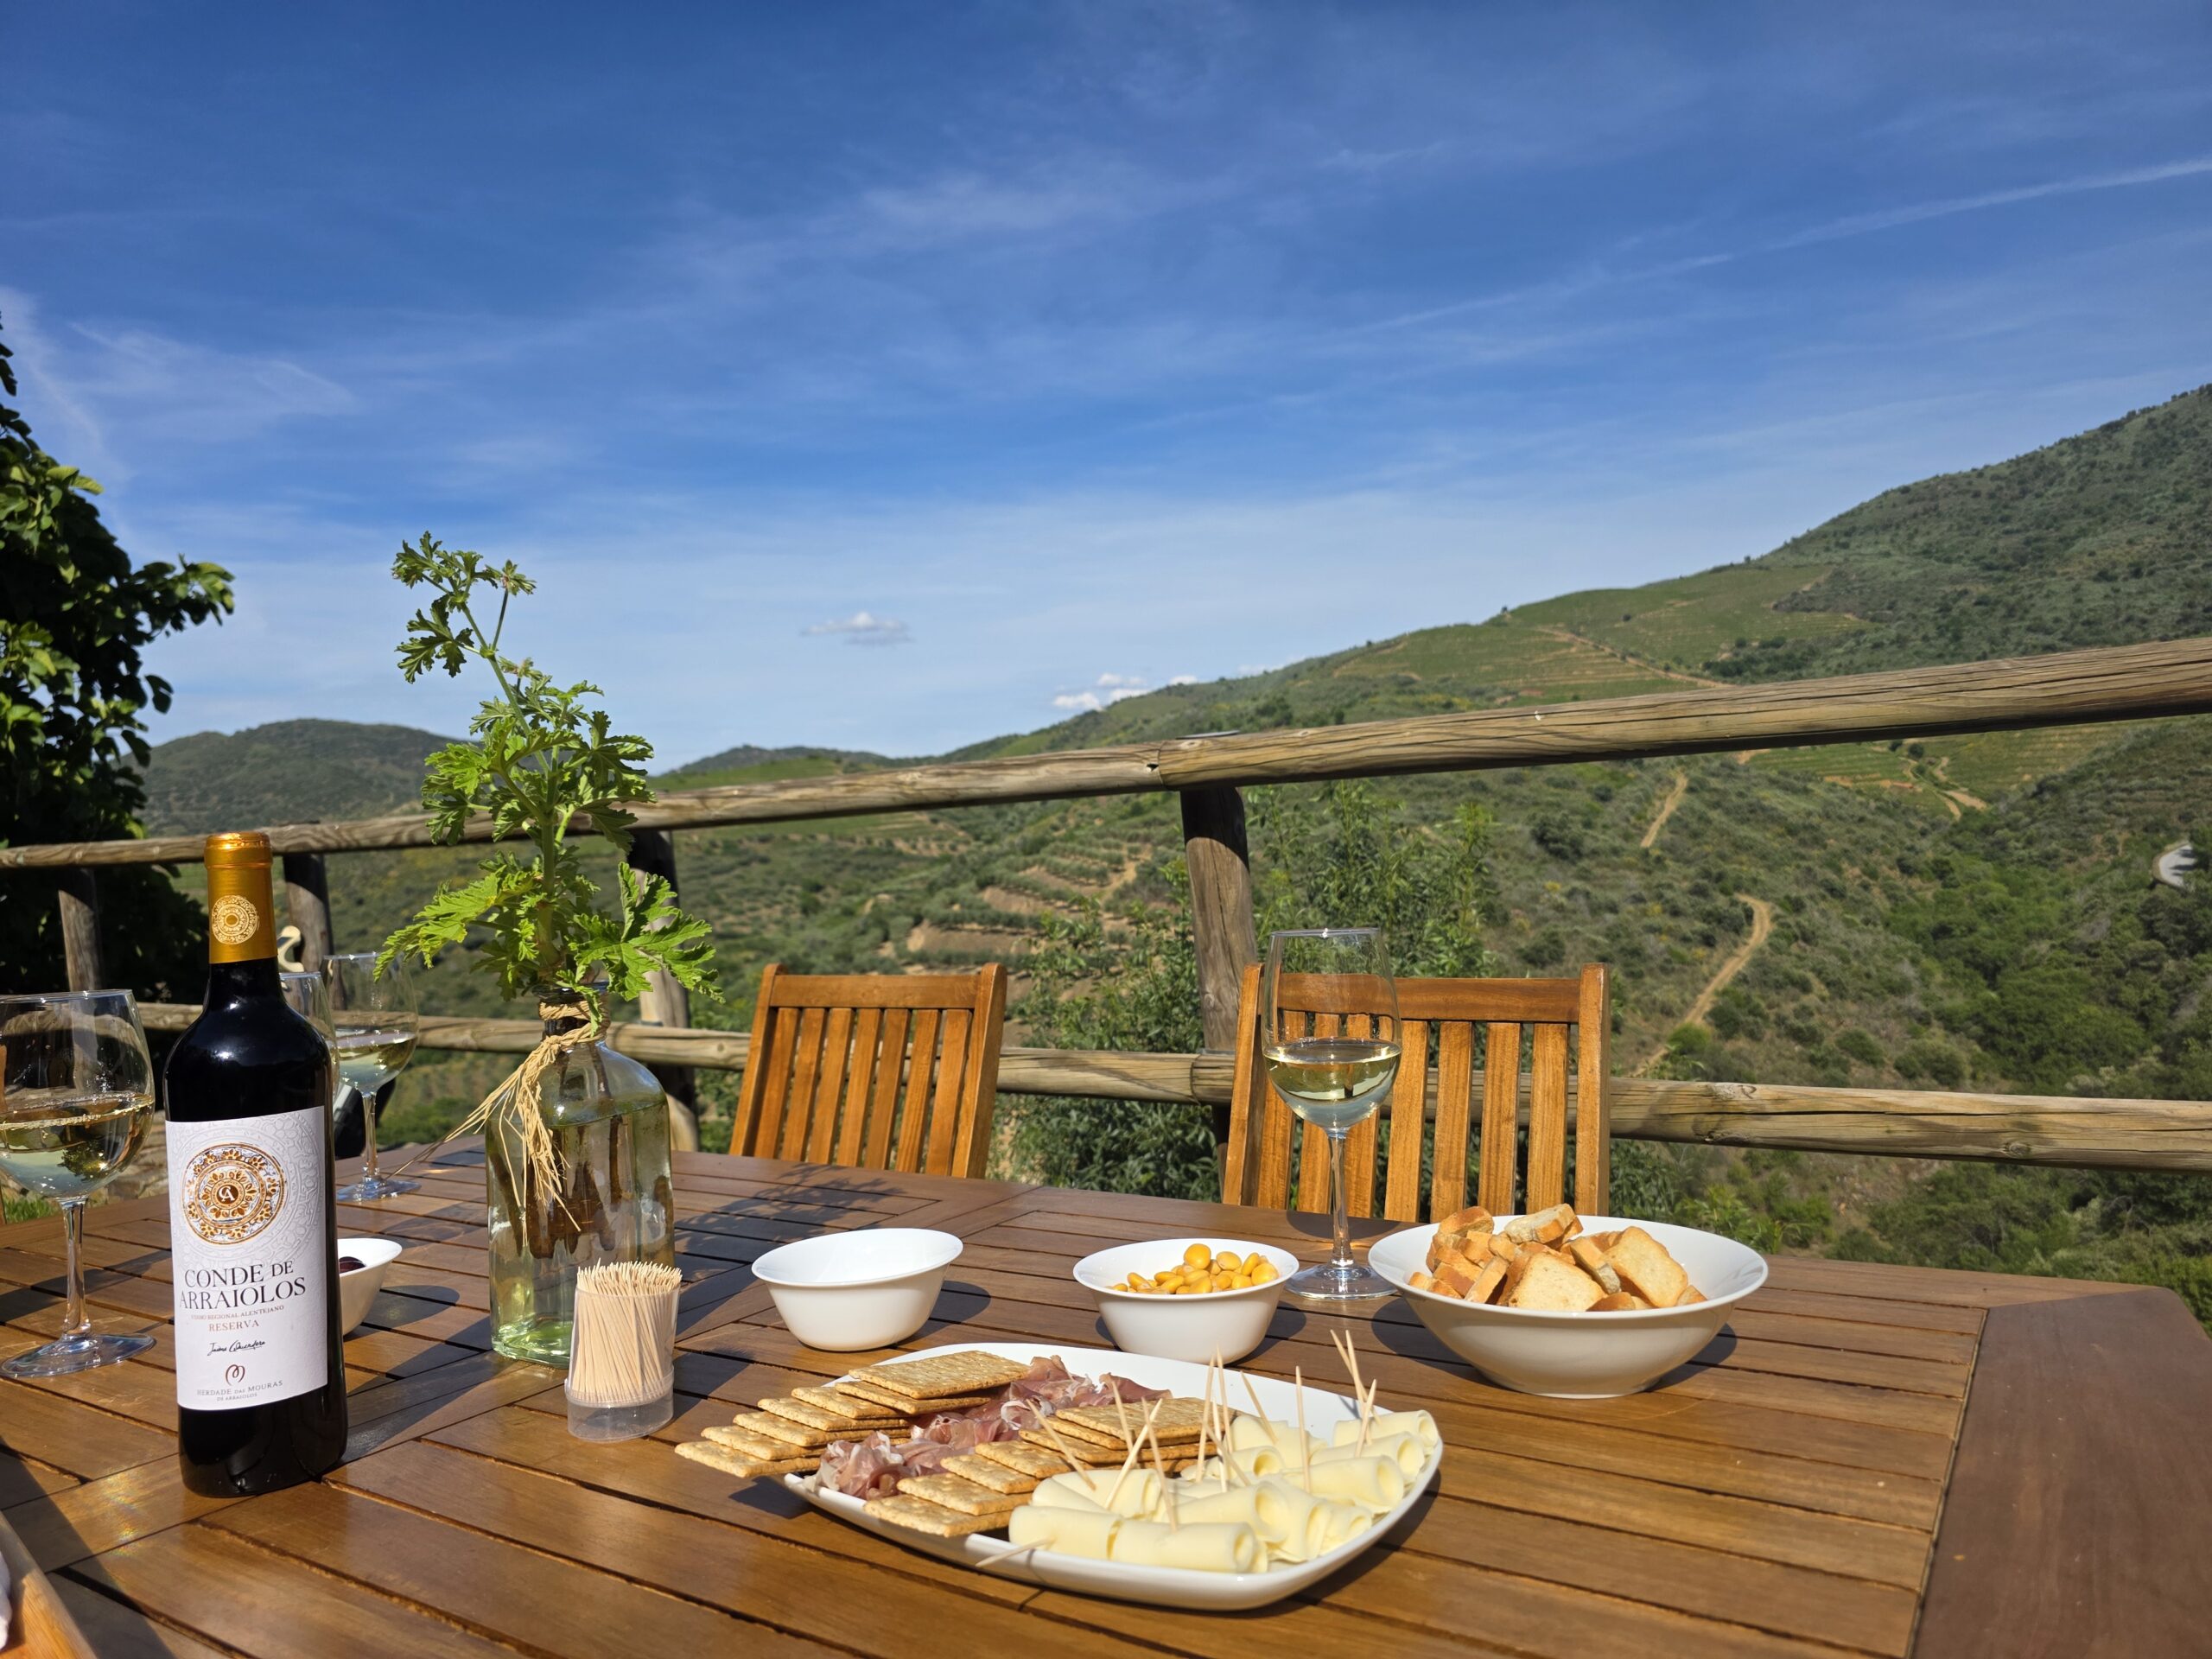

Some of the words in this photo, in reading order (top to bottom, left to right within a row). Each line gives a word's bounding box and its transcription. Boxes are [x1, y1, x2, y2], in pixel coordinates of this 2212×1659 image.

[184, 1263, 264, 1288] CONDE
[271, 1260, 294, 1277] DE
[180, 1276, 306, 1310] ARRAIOLOS
[240, 1305, 284, 1318] ALENTEJANO
[209, 1319, 259, 1332] RESERVA
[248, 1380, 283, 1392] MOURAS
